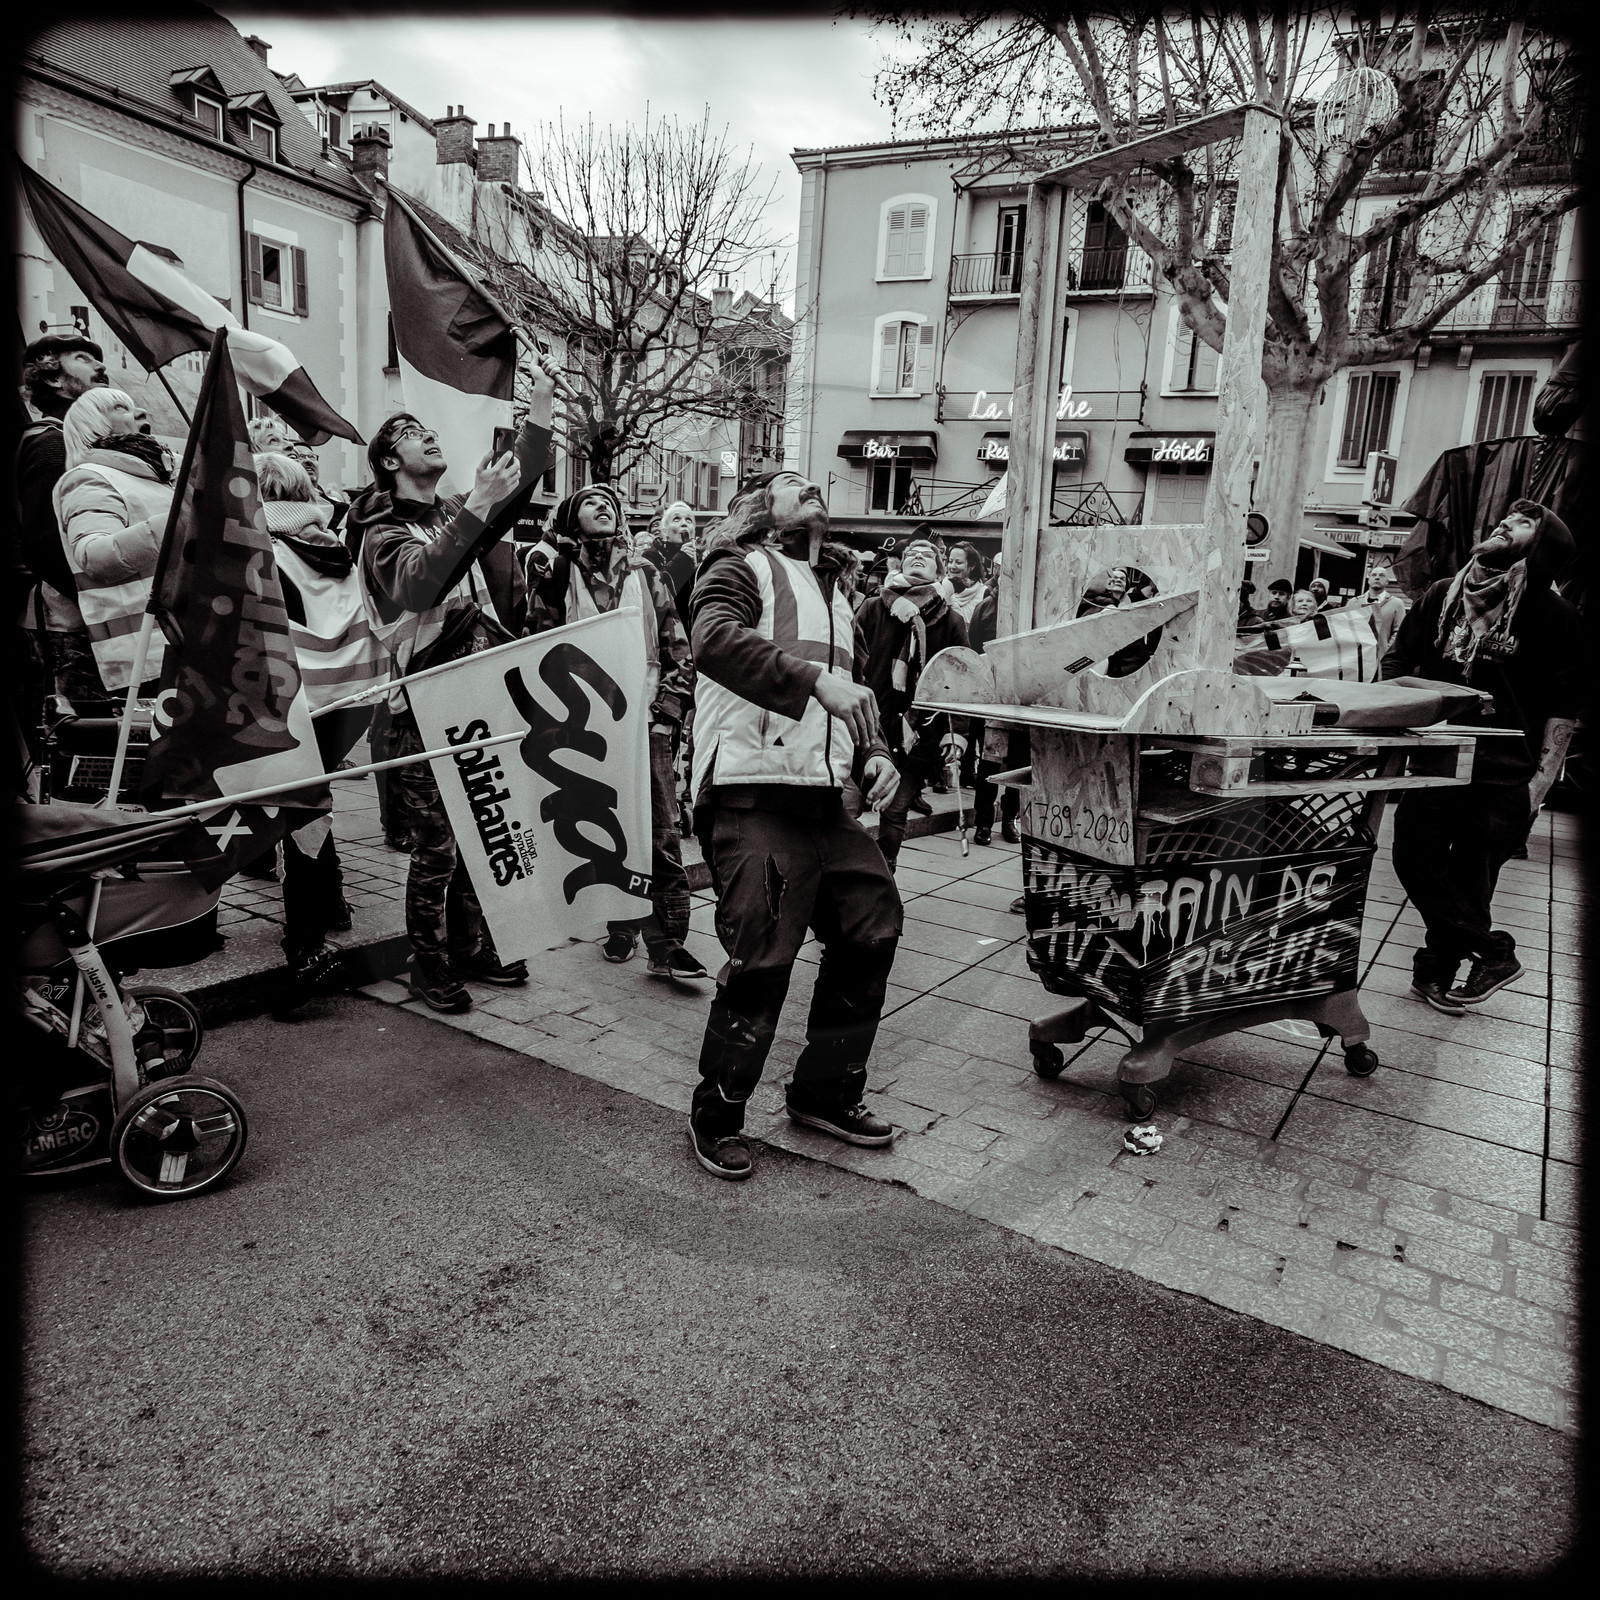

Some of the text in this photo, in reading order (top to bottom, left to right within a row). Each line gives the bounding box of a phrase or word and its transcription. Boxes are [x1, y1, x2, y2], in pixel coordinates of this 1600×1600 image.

[968, 390, 1003, 419] La
[865, 439, 895, 459] Bar
[1154, 439, 1206, 461] Hôtel
[444, 719, 526, 887] Solidaires
[1022, 801, 1130, 844] 1789-2020
[513, 832, 534, 877] syndicale
[523, 828, 538, 859] Union
[87, 967, 108, 1000] lusive
